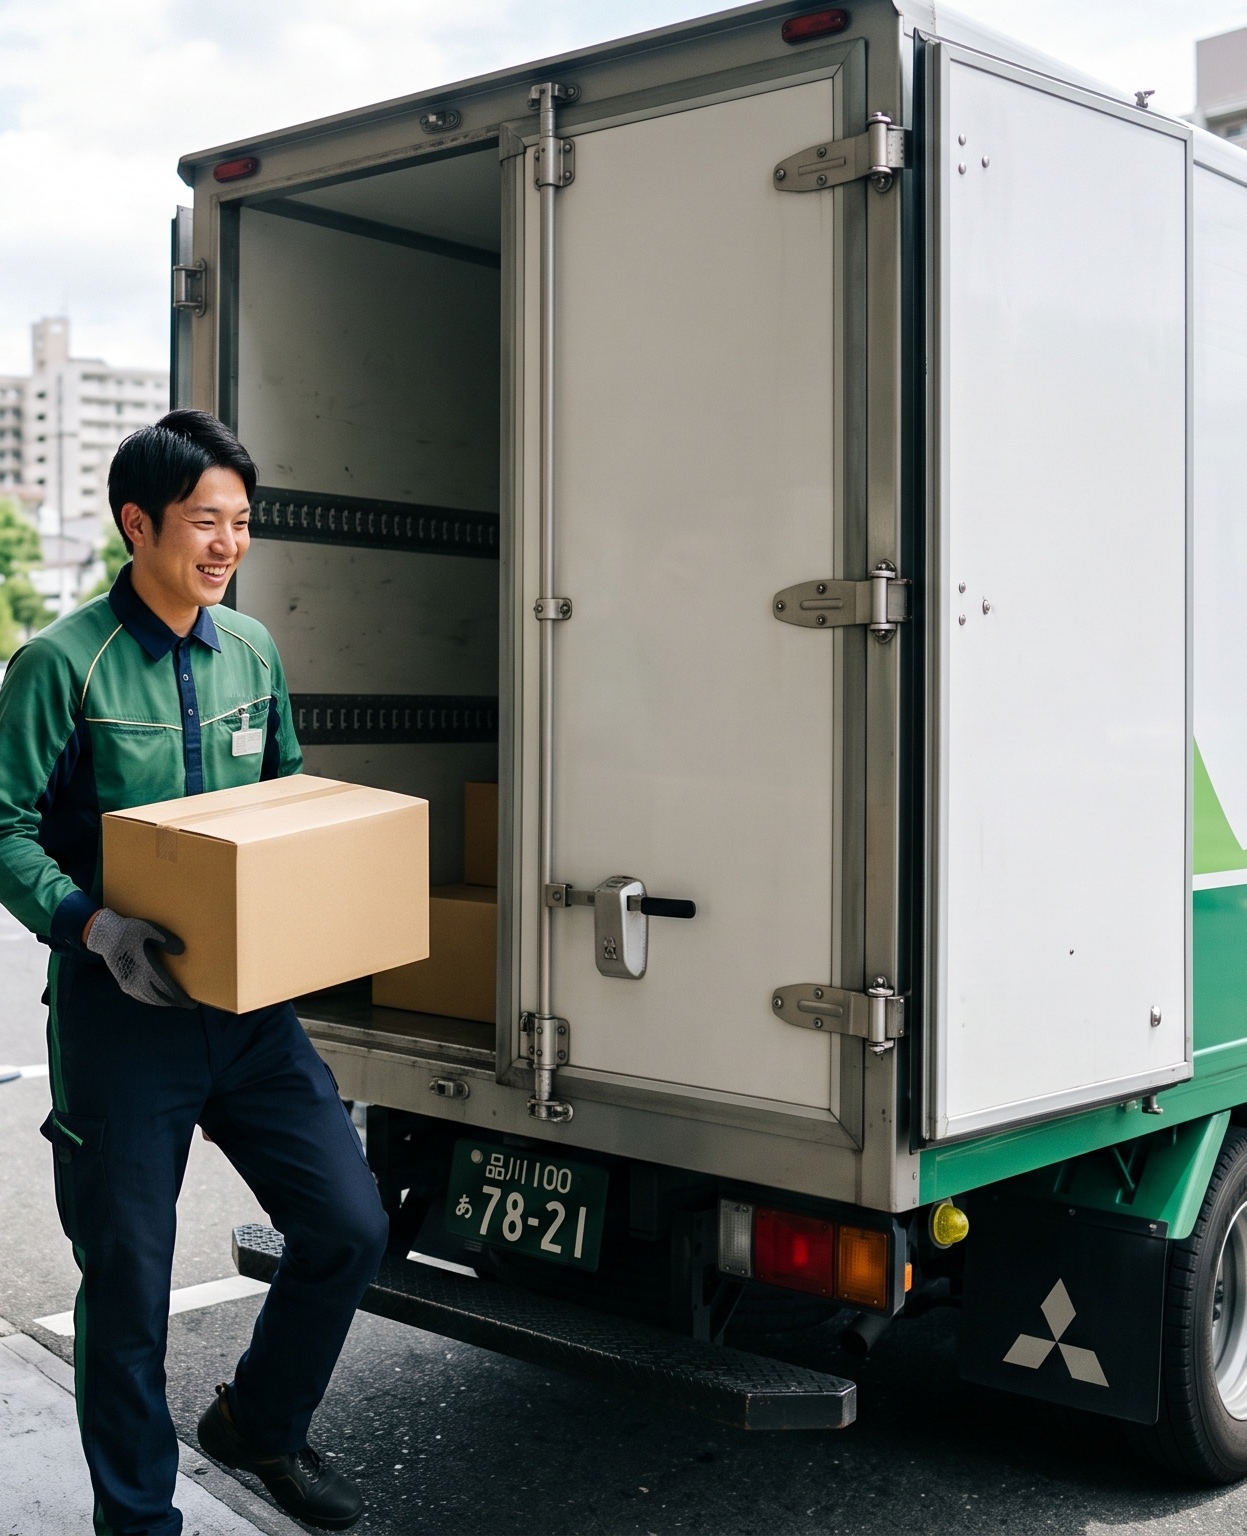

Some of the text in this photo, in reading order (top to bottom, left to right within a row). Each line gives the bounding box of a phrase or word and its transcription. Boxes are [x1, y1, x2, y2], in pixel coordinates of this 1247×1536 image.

[485, 1153, 572, 1194] 品川 100
[455, 1185, 587, 1259] あ 78-21
